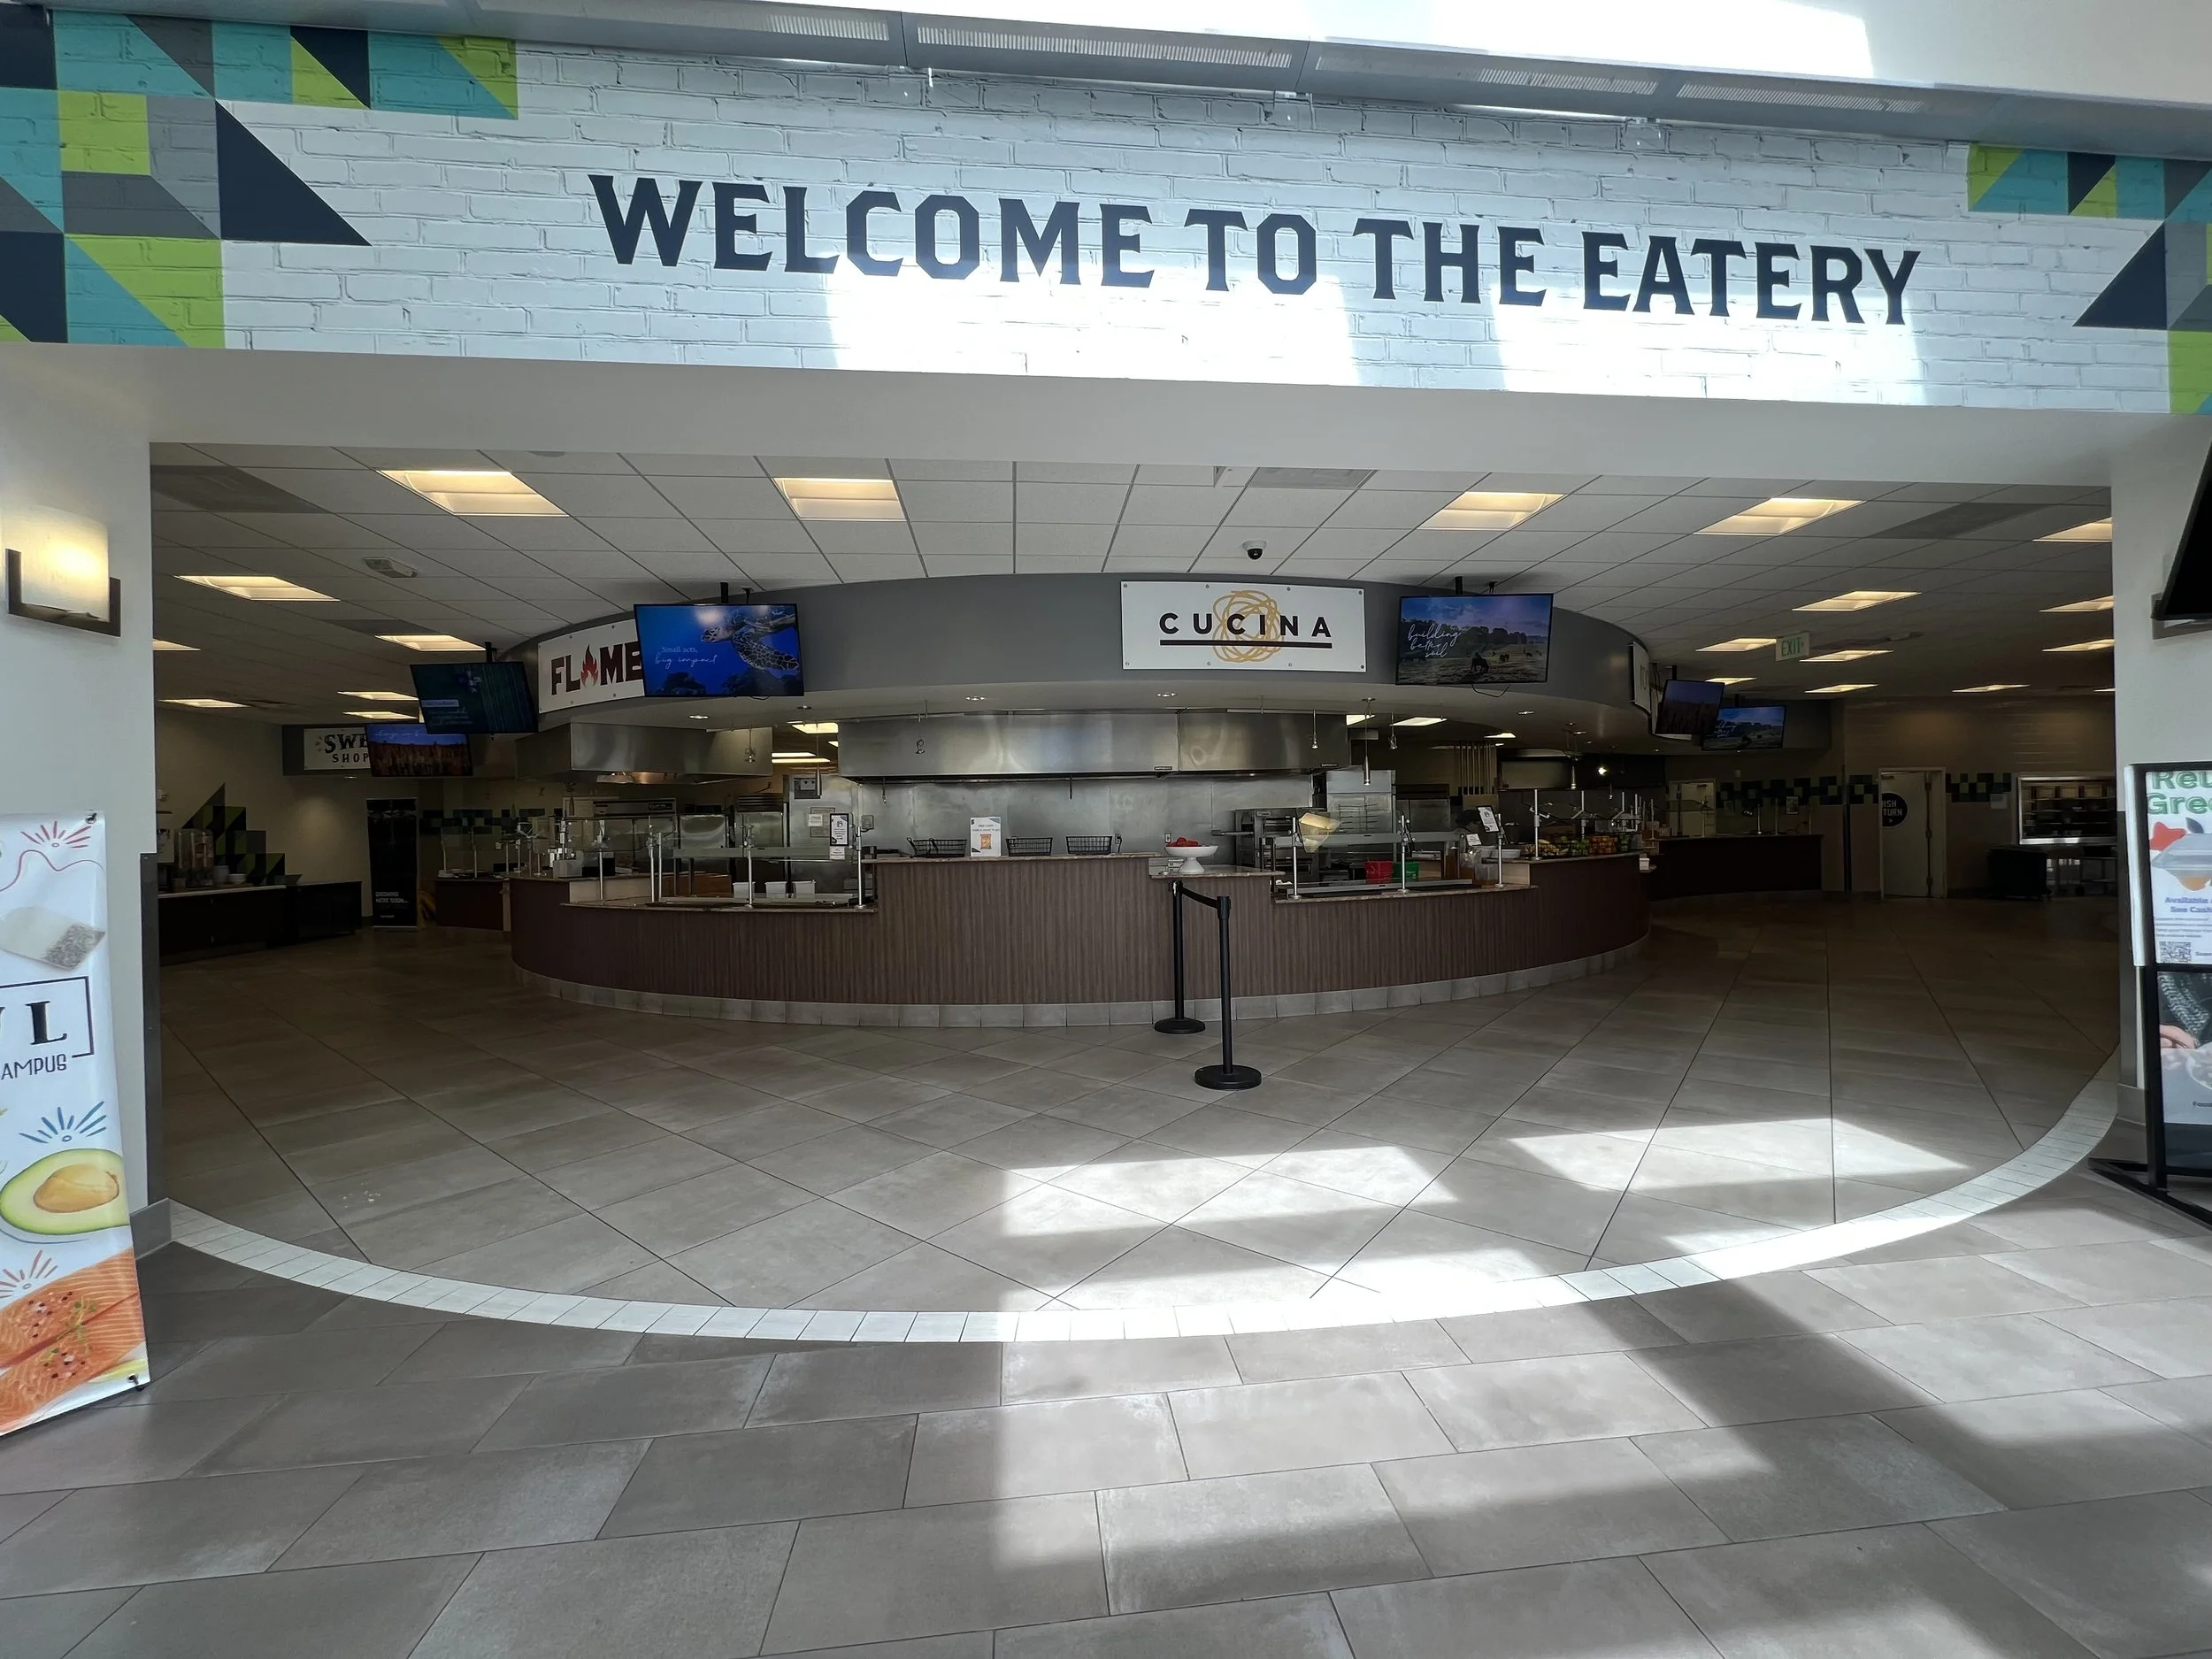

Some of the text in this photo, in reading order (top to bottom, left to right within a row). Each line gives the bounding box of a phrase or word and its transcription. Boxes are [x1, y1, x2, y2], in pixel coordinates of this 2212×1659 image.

[588, 174, 1921, 326] WELCOME TO THE EATERY
[1158, 612, 1333, 638] CUCINA
[1407, 623, 1462, 648] building
[1409, 637, 1442, 650] better
[1425, 642, 1448, 657] soil
[1781, 637, 1801, 657] EXIT
[678, 654, 718, 668] impact
[2147, 792, 2212, 814] Gre
[1, 1054, 68, 1080] AMPUS
